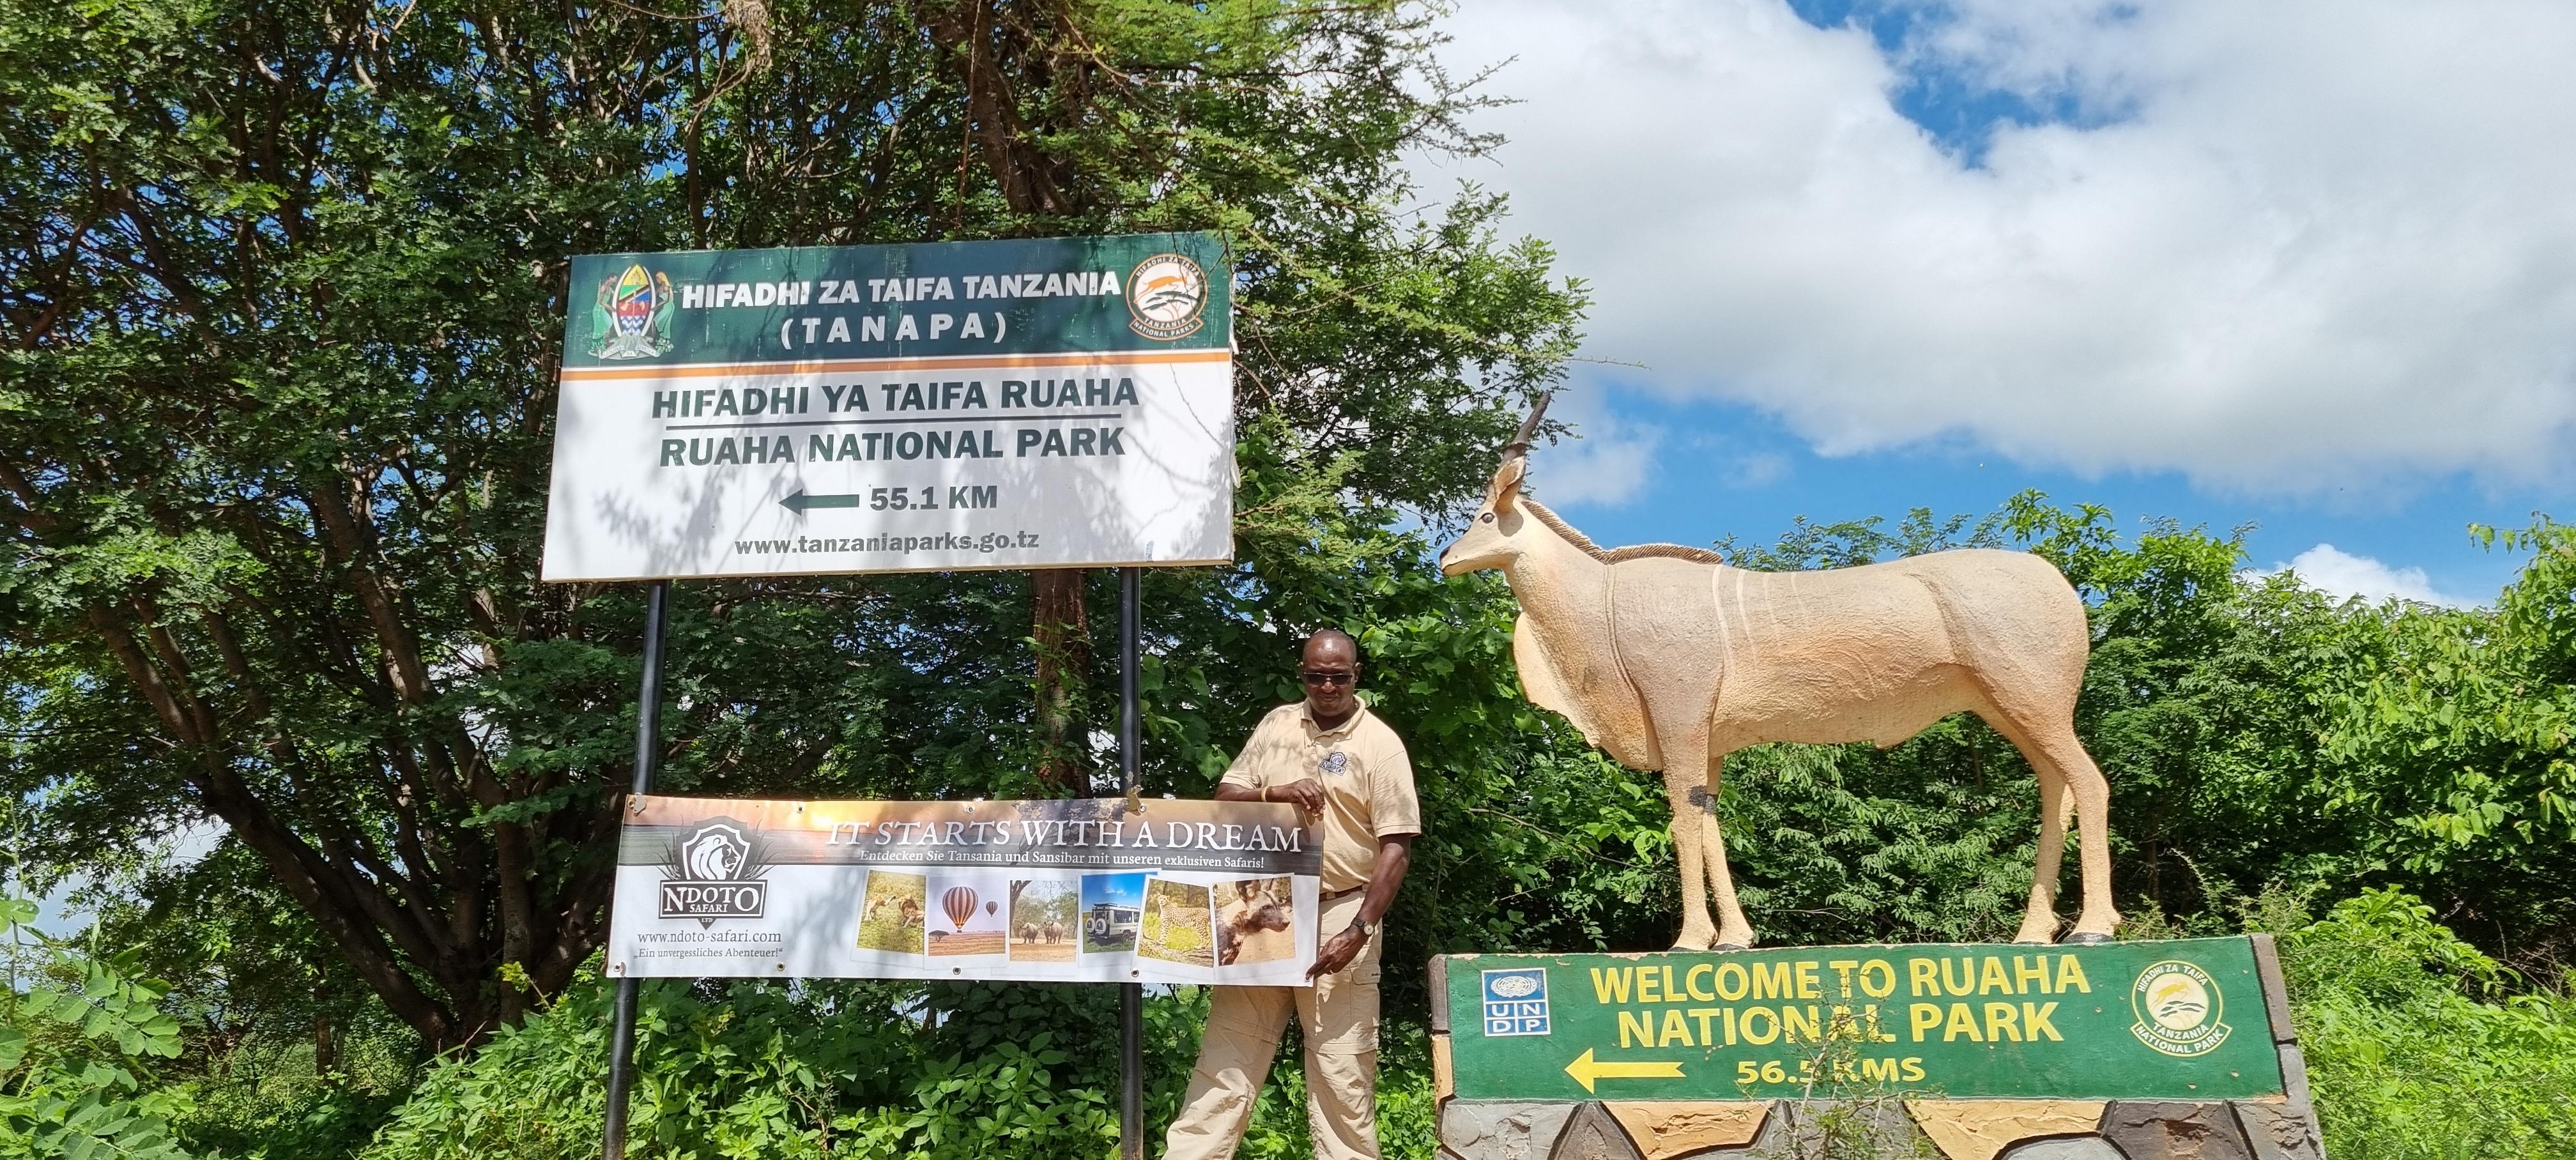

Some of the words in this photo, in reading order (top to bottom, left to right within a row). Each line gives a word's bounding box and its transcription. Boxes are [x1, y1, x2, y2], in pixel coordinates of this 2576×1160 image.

[1135, 257, 1165, 277] HIFADHI
[1182, 259, 1199, 277] TAIFA
[682, 281, 810, 309] HIFADHI
[818, 279, 860, 304] ZA
[868, 276, 954, 303] TAIFA
[963, 271, 1121, 299] TANZANIA
[781, 312, 1006, 350] (TANAPA)
[1133, 321, 1168, 337] NATIONAL
[1171, 323, 1194, 337] PARKS
[1144, 317, 1186, 329] TANZANIA
[652, 386, 809, 419] HIFADHI
[822, 385, 870, 413] YA
[882, 381, 988, 411] TAIFA
[1000, 378, 1140, 409] RUAHA
[660, 435, 795, 468] RUAHA
[809, 429, 1004, 462] NATIONAL
[1016, 427, 1126, 458] PARK
[870, 486, 939, 511] 55.1
[949, 485, 997, 509] KM
[735, 530, 1039, 555] www.tanzaniaparks.go.tz
[826, 821, 870, 845] IT
[875, 820, 1011, 846] STARTS
[1021, 820, 1125, 848] WITH
[1131, 820, 1158, 848] A
[1166, 821, 1302, 853] DREAM
[859, 850, 923, 862] Entdecken
[927, 850, 944, 862] Sie
[948, 850, 1002, 862] Tansania
[1005, 850, 1030, 862] und
[1032, 850, 1085, 864] Sansibar
[1088, 853, 1110, 864] mit
[1113, 855, 1162, 865] unseren
[1164, 855, 1222, 867] exklusiven
[1224, 856, 1264, 869] Safaris!
[664, 887, 760, 912] NDOTO
[689, 903, 728, 913] SAFARI
[638, 929, 782, 943] www.ndoto-safari.com
[657, 947, 723, 959] unvergessliches
[1590, 960, 1822, 1004] WELCOME
[1829, 959, 1897, 999] TO
[1908, 954, 2092, 996] RUAHA
[2136, 966, 2164, 993] HIFADHI
[2165, 964, 2179, 973] ZA
[2183, 965, 2209, 986] TAIFA
[1618, 1004, 1897, 1048] NATIONAL
[1910, 1002, 2065, 1042] PARK
[2152, 1022, 2209, 1040] TANZANIA
[2136, 1026, 2192, 1053] NATIONAL
[2194, 1028, 2224, 1052] PARK
[1833, 1057, 1926, 1083] KMS
